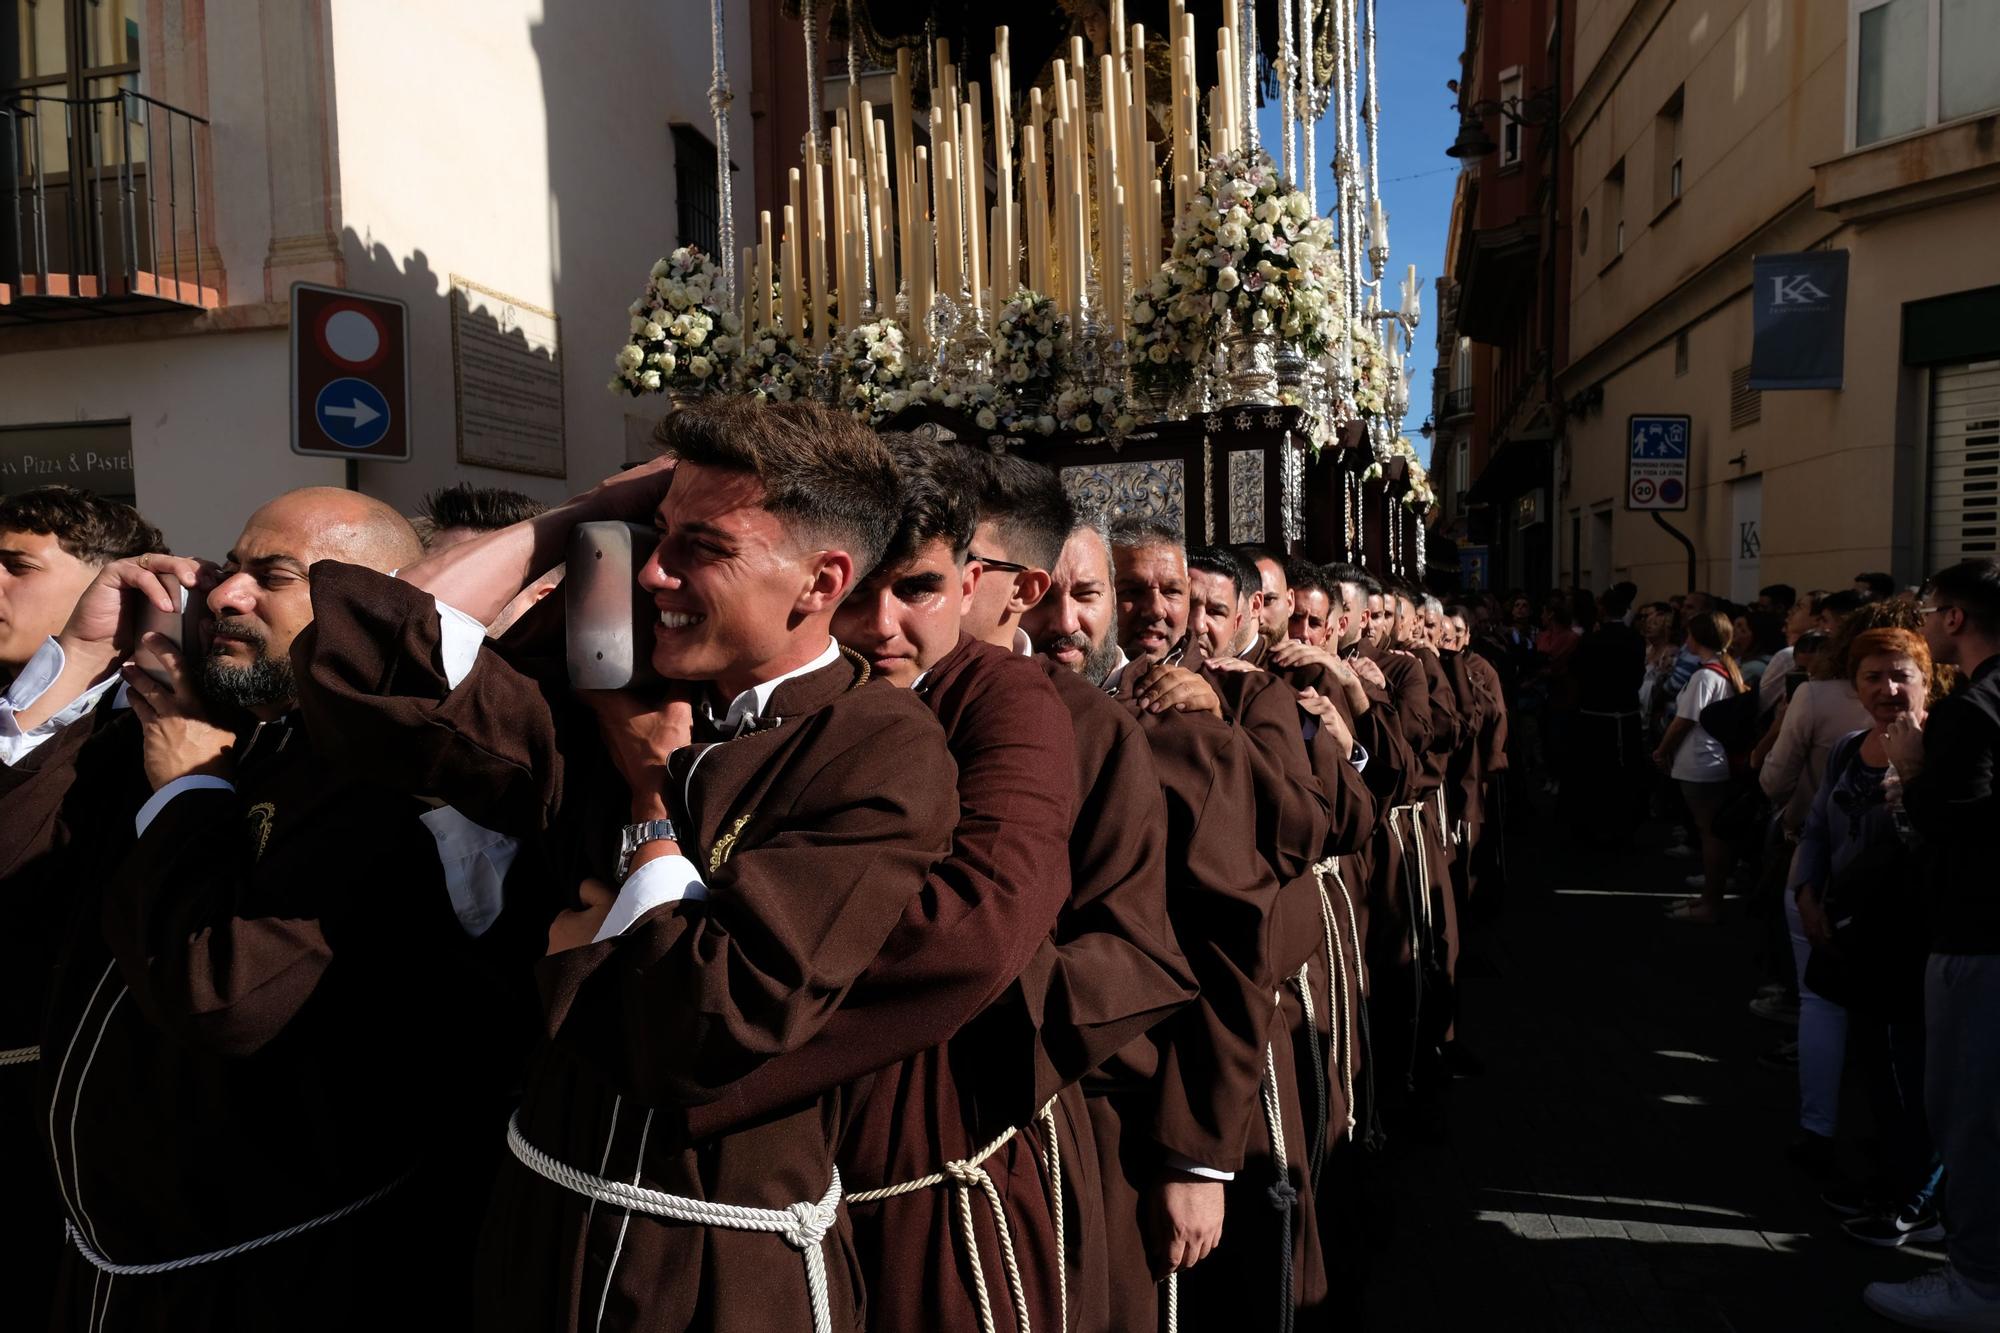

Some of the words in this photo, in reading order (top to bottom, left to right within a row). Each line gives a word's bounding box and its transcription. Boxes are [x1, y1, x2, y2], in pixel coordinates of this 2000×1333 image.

[1768, 274, 1832, 305] KA
[68, 453, 80, 472] &
[1637, 486, 1652, 495] 20
[1739, 520, 1761, 559] KA
